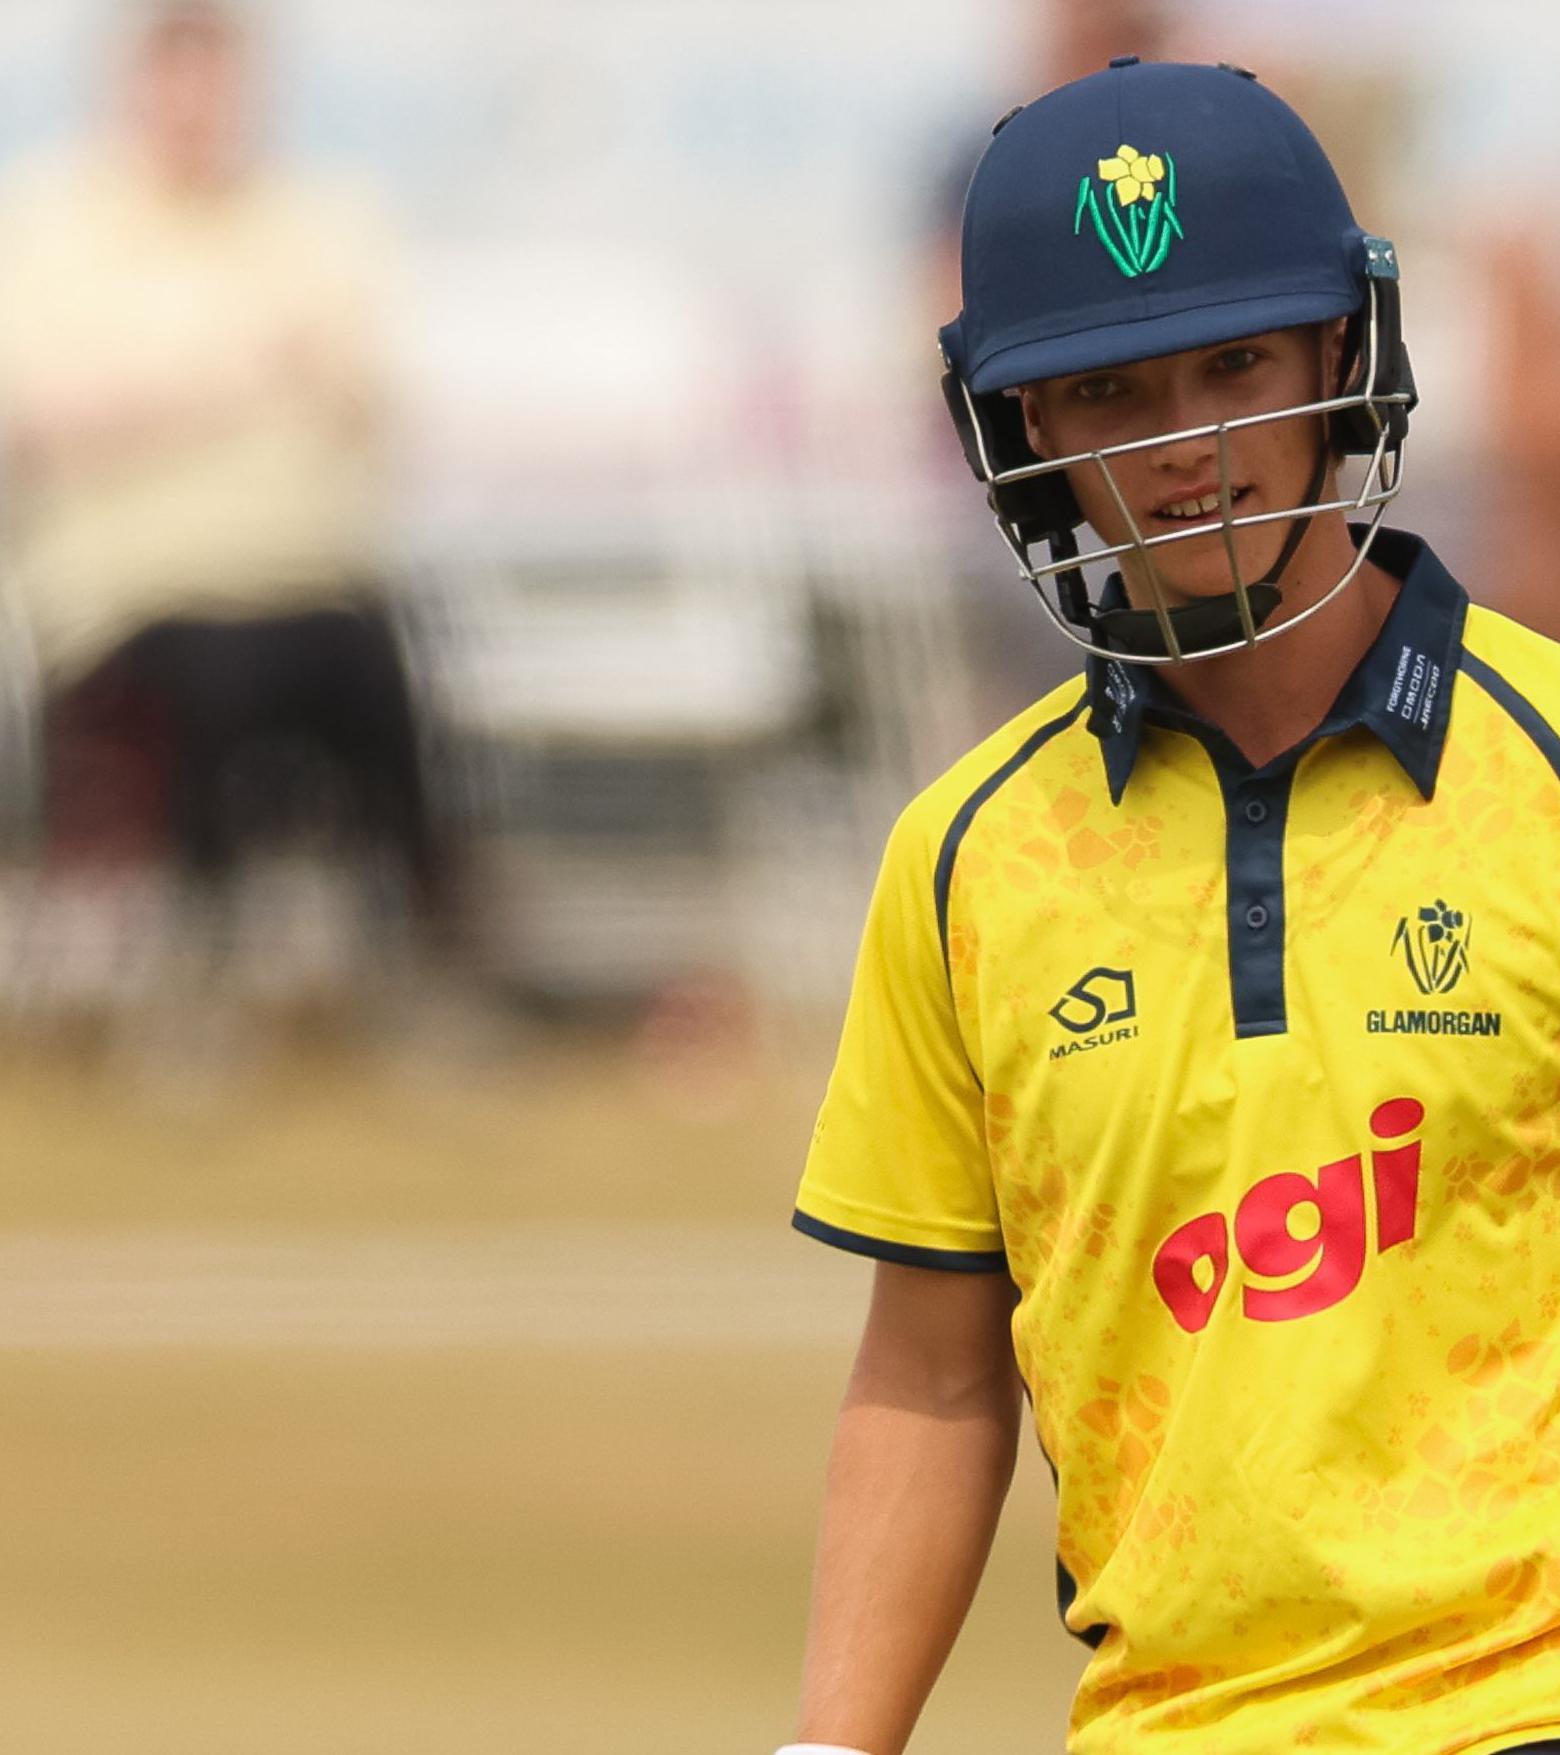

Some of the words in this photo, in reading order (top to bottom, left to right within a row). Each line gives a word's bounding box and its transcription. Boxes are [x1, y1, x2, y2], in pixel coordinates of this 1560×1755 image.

[1367, 1010, 1501, 1036] GLAMORGAN
[1049, 1025, 1139, 1061] MASURI
[1152, 1097, 1425, 1334] ogi
